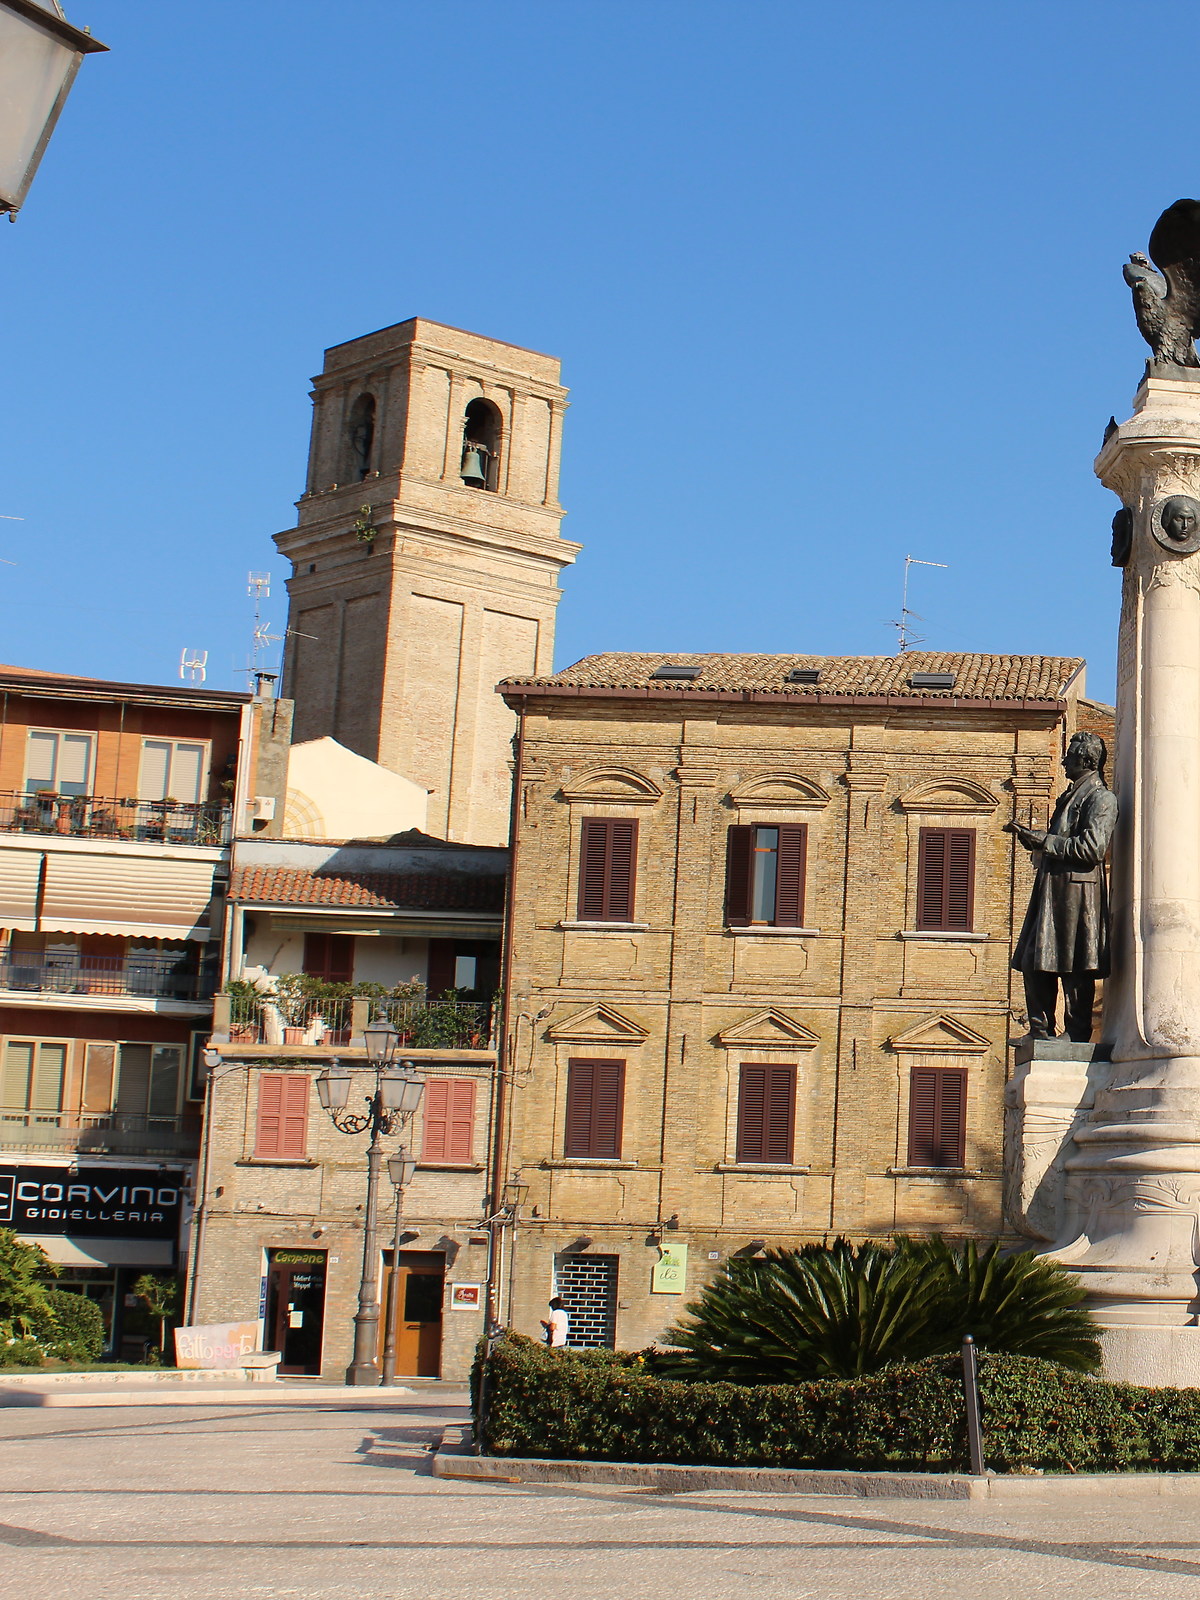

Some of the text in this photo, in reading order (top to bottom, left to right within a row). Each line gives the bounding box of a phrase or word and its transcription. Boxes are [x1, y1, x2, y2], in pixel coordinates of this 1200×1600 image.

[17, 1181, 178, 1206] CORVINO
[26, 1208, 163, 1222] GIOIELLERIA
[275, 1251, 324, 1264] Campane
